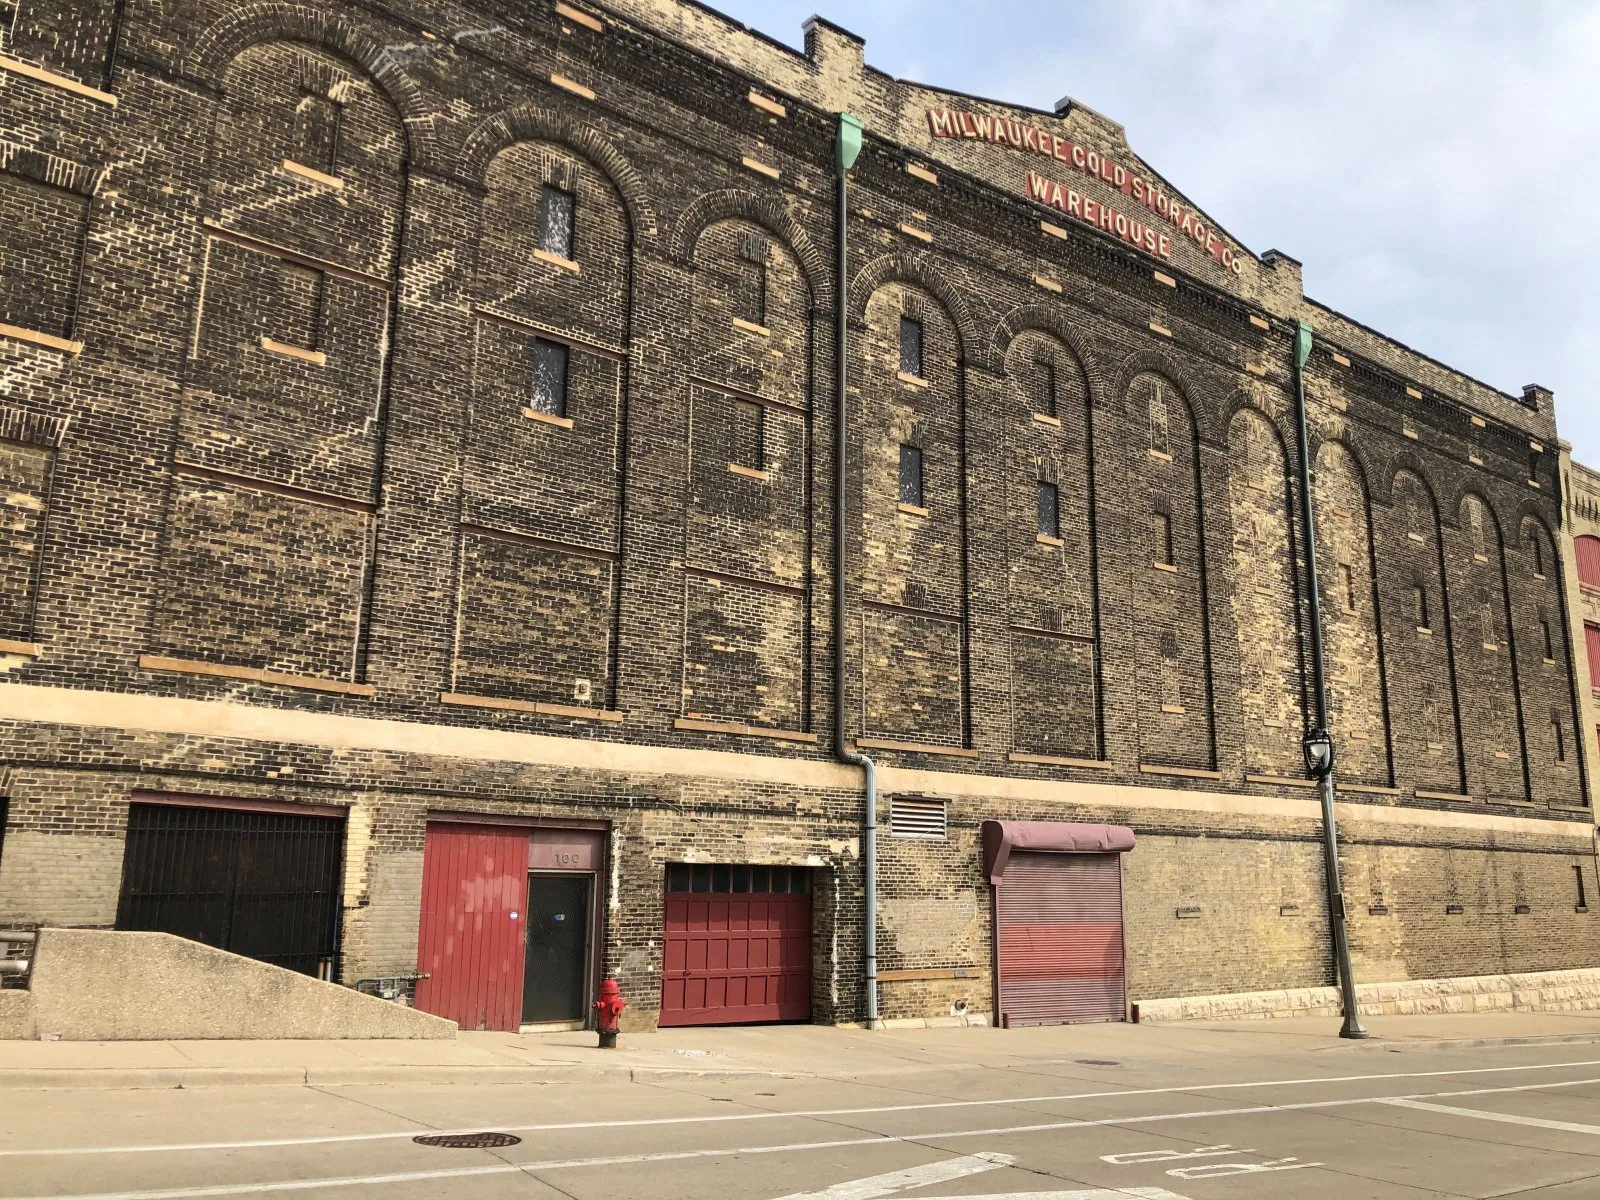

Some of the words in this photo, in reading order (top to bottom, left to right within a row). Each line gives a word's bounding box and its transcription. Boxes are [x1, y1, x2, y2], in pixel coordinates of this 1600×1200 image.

[929, 109, 1067, 161] MILWAUKEE
[1071, 145, 1126, 187] COLD
[1132, 177, 1219, 255] STORAGE
[1029, 170, 1170, 257] WAREHOUSE
